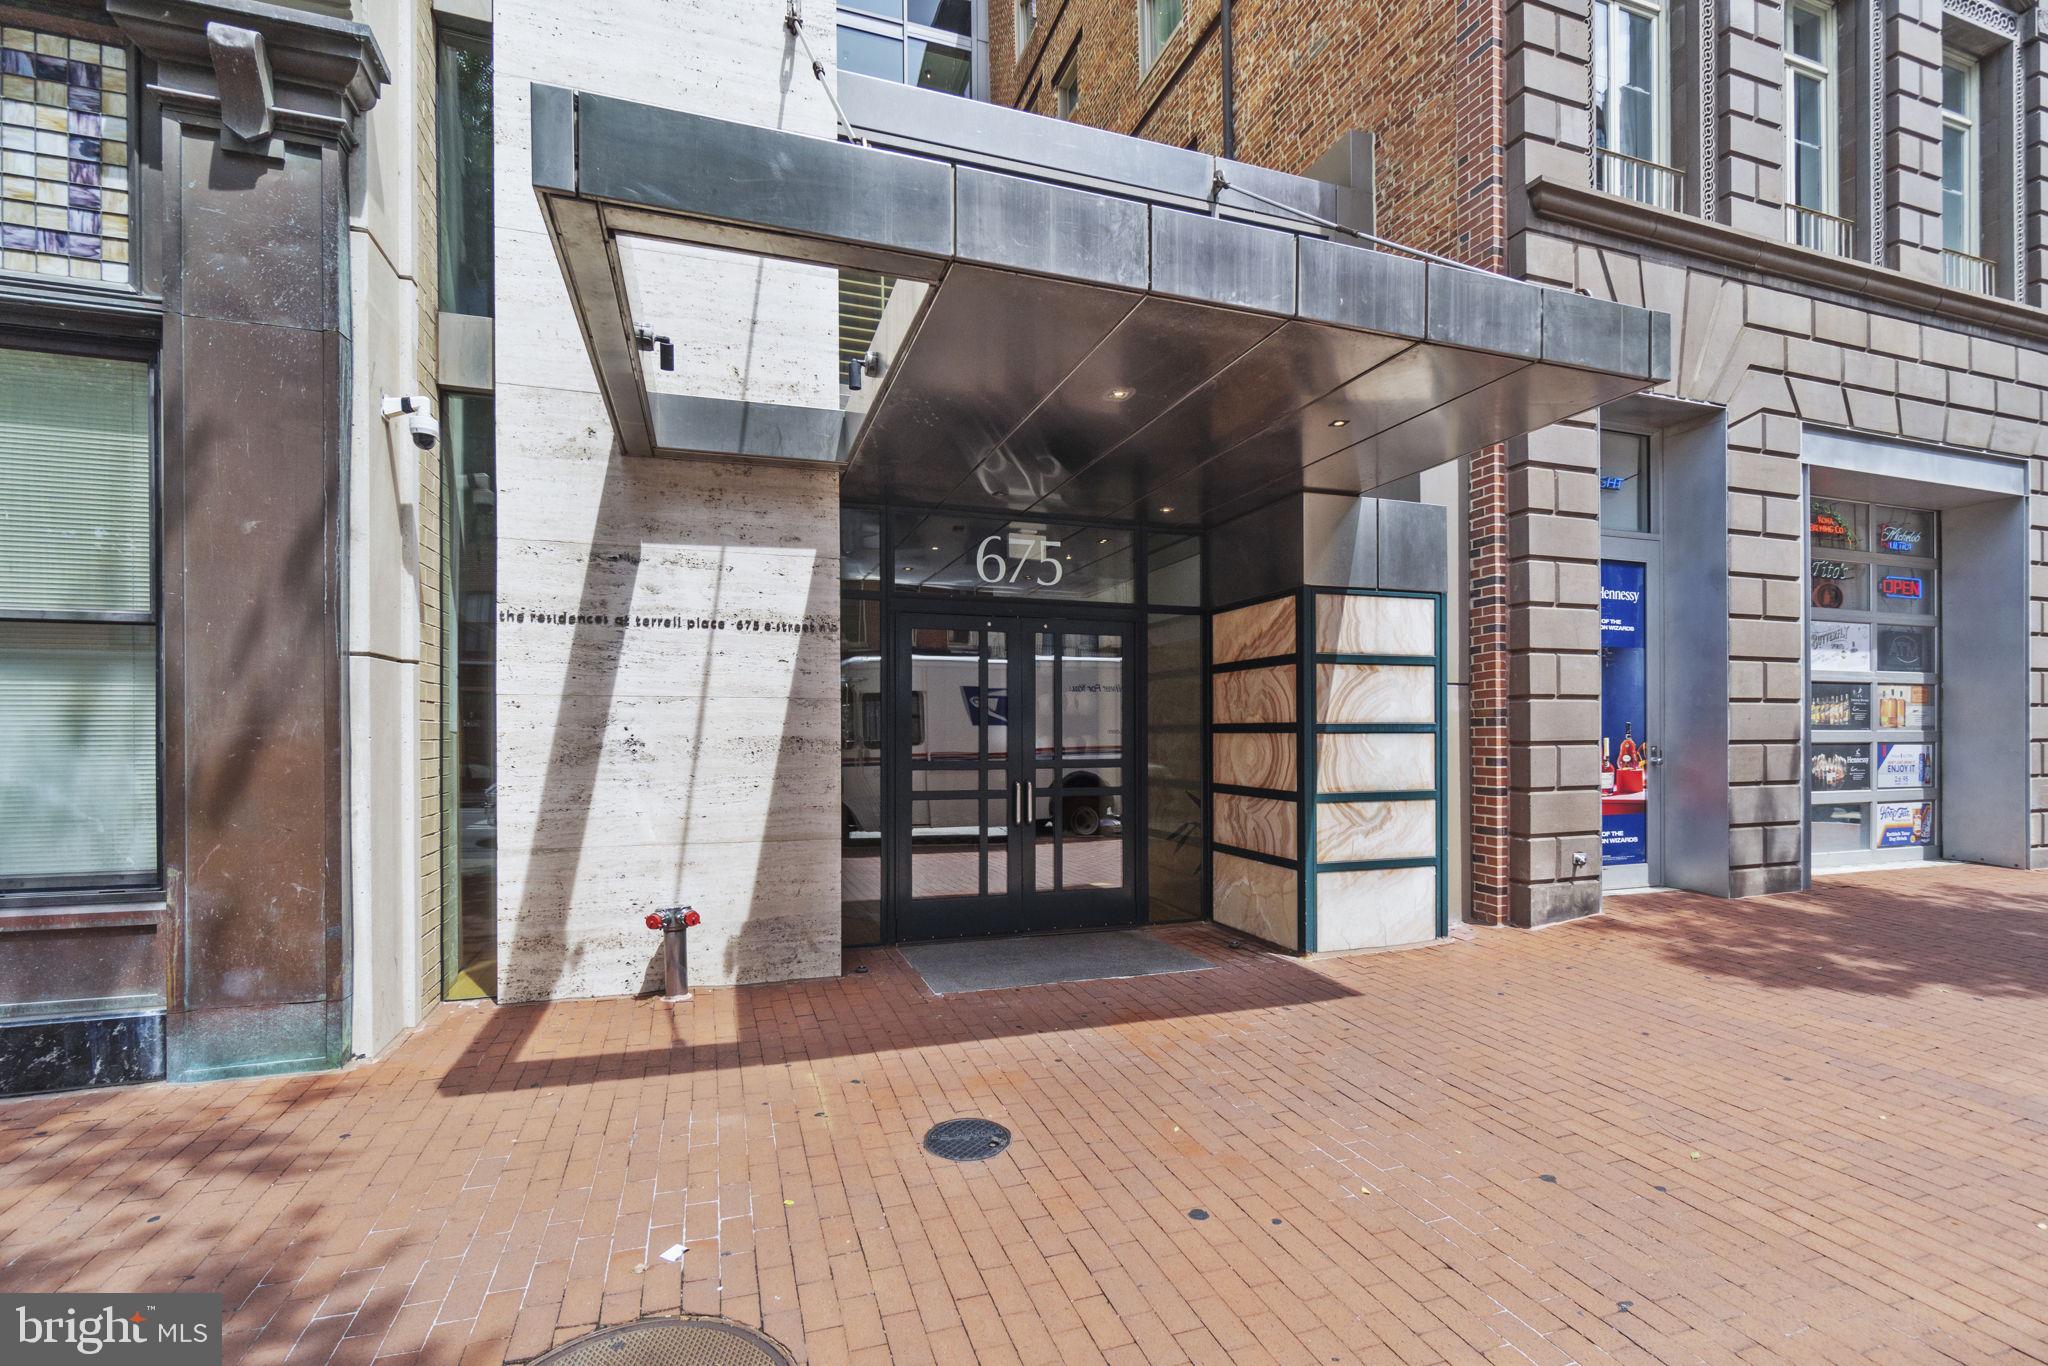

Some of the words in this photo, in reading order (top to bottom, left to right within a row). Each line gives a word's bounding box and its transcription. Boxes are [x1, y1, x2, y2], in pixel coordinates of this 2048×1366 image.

[976, 535, 1063, 586] 675
[1811, 560, 1849, 580] Tito's
[1883, 580, 1920, 595] OPEN
[499, 610, 525, 623] the
[530, 610, 609, 625] residences
[614, 613, 630, 626] at
[636, 615, 682, 629] terrell
[687, 616, 725, 631] place
[1887, 764, 1908, 773] ENJOY
[1909, 764, 1916, 773] IT
[1609, 836, 1639, 844] WIZARDS
